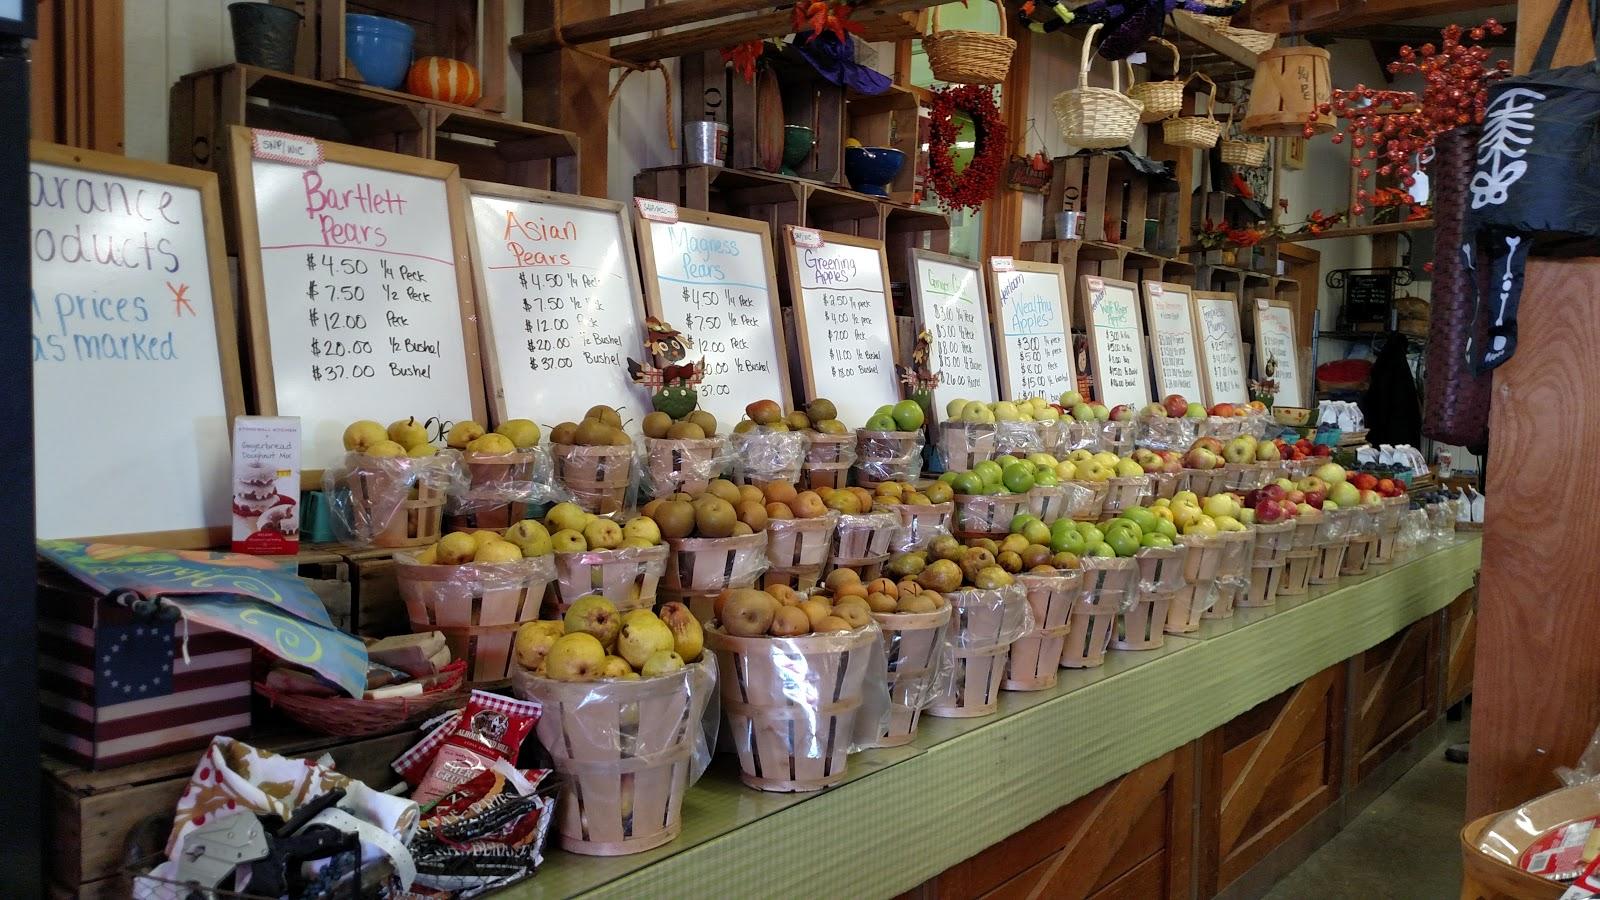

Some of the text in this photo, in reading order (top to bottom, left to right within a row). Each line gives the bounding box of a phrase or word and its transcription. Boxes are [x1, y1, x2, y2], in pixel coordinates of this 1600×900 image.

[302, 169, 408, 219] Bartlett
[318, 213, 388, 248] Pears
[503, 209, 577, 242] Asian
[507, 241, 571, 267] Pears
[667, 225, 741, 264] Magness
[306, 252, 428, 283] $4.50 1/4 Peck
[682, 252, 727, 281] Pears
[804, 248, 857, 279] Greening
[518, 271, 564, 291] $4.50
[815, 269, 850, 285] Apples
[306, 280, 433, 304] $7.50 1/2 Peck
[681, 286, 721, 311] $4.50
[738, 294, 757, 308] Peck
[54, 291, 150, 337] prices
[522, 297, 565, 313] $7.50
[1011, 291, 1055, 321] Wealthy
[308, 307, 411, 332] $12.00 Peck
[524, 317, 570, 334] $12.00
[685, 311, 760, 332] $7.50 1/2 Peck
[1012, 313, 1050, 336] Apples
[73, 331, 180, 362] marked
[311, 336, 441, 358] $20.00 1/2 Bushel
[527, 336, 571, 353] $20.00
[592, 332, 623, 348] Bushel
[729, 336, 752, 350] Peck
[312, 362, 432, 382] $37.00 Bushel
[529, 350, 621, 371] $37.00 Bushel
[733, 356, 746, 374] 1/2
[744, 358, 772, 376] Bushel
